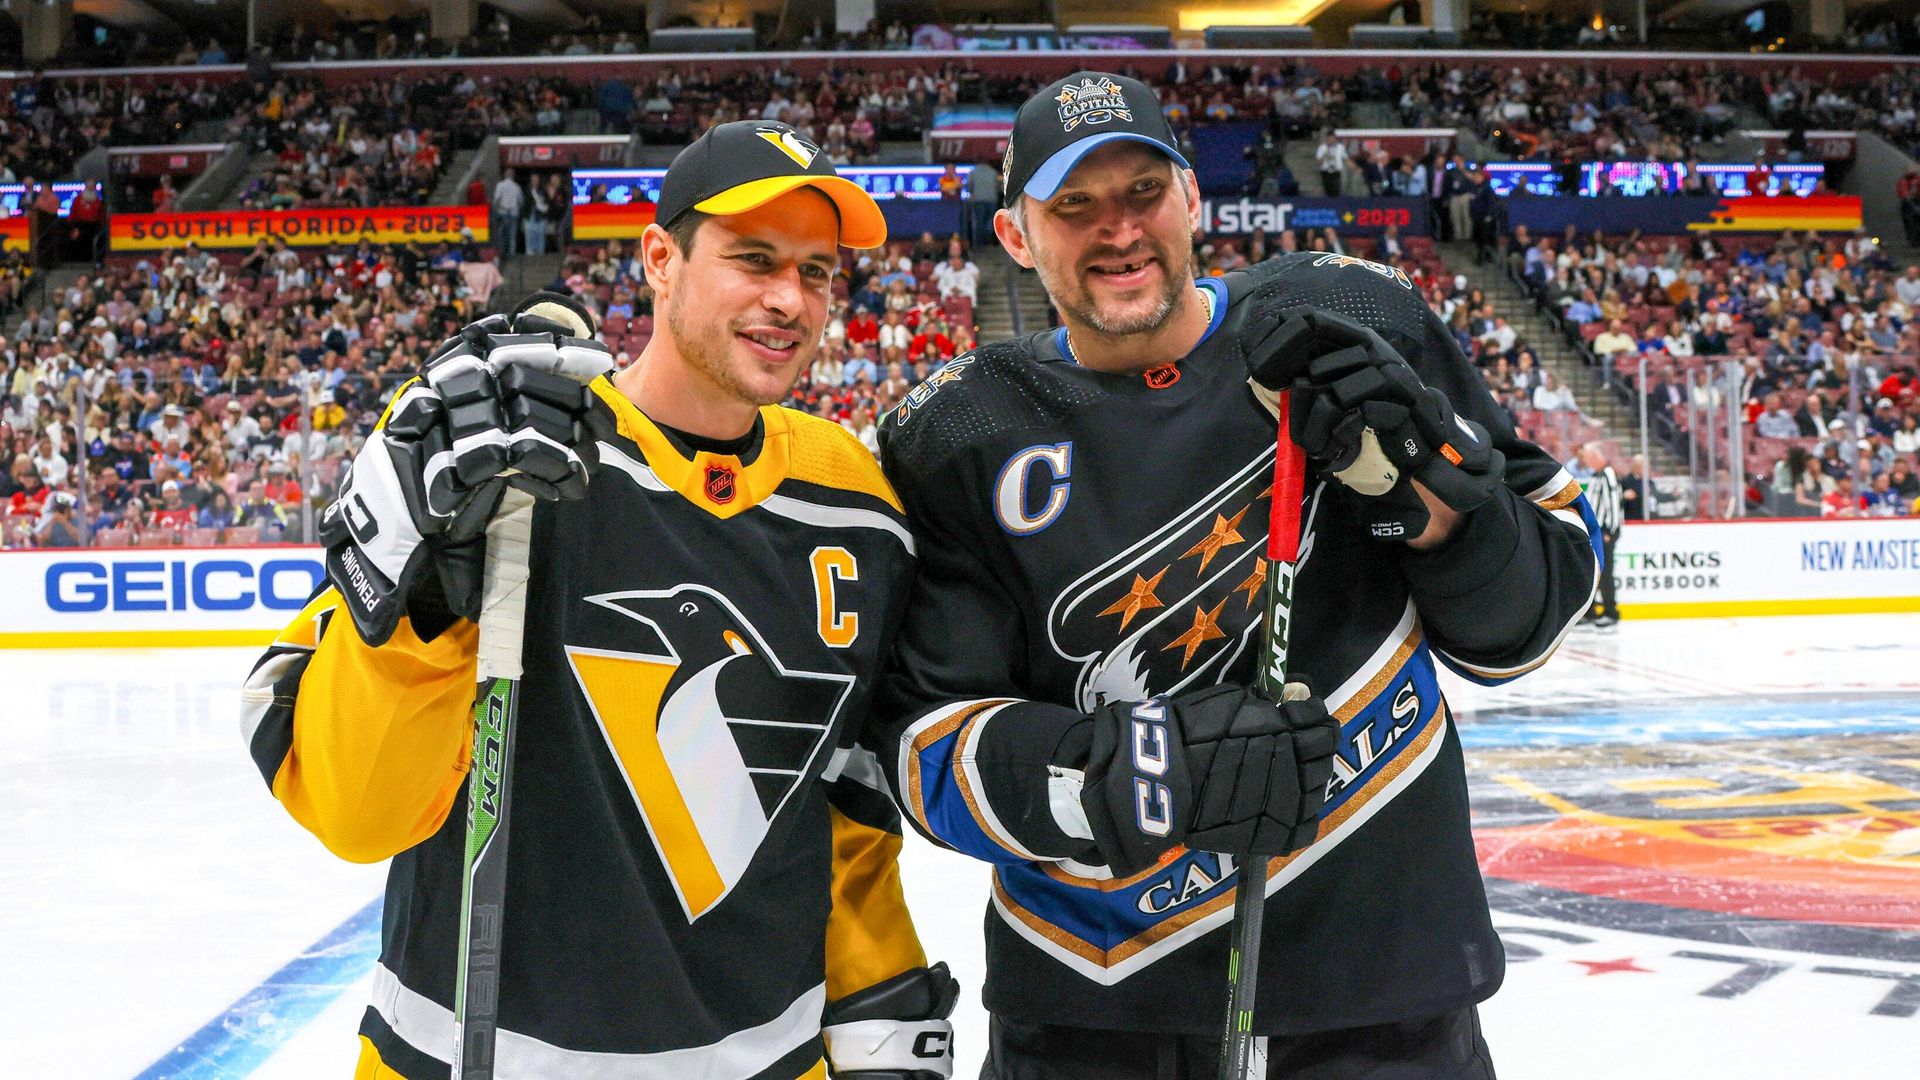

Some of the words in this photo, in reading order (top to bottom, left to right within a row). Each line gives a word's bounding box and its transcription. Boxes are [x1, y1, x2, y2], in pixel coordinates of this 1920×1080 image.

[1063, 97, 1126, 116] CAPITALS
[131, 219, 232, 240] SOUTH
[247, 216, 378, 237] FLORIDA
[403, 213, 465, 234] 2023
[1404, 438, 1419, 457] GR8
[711, 475, 730, 494] NHL
[993, 441, 1073, 537] C
[1372, 526, 1405, 537] CCM
[1801, 540, 1847, 571] NEW
[1852, 539, 1920, 570] AMSTE
[45, 559, 326, 613] GEICO
[341, 546, 380, 613] PENGUINS
[809, 546, 859, 648] C
[1270, 560, 1295, 685] CCM
[481, 693, 505, 819] CCM
